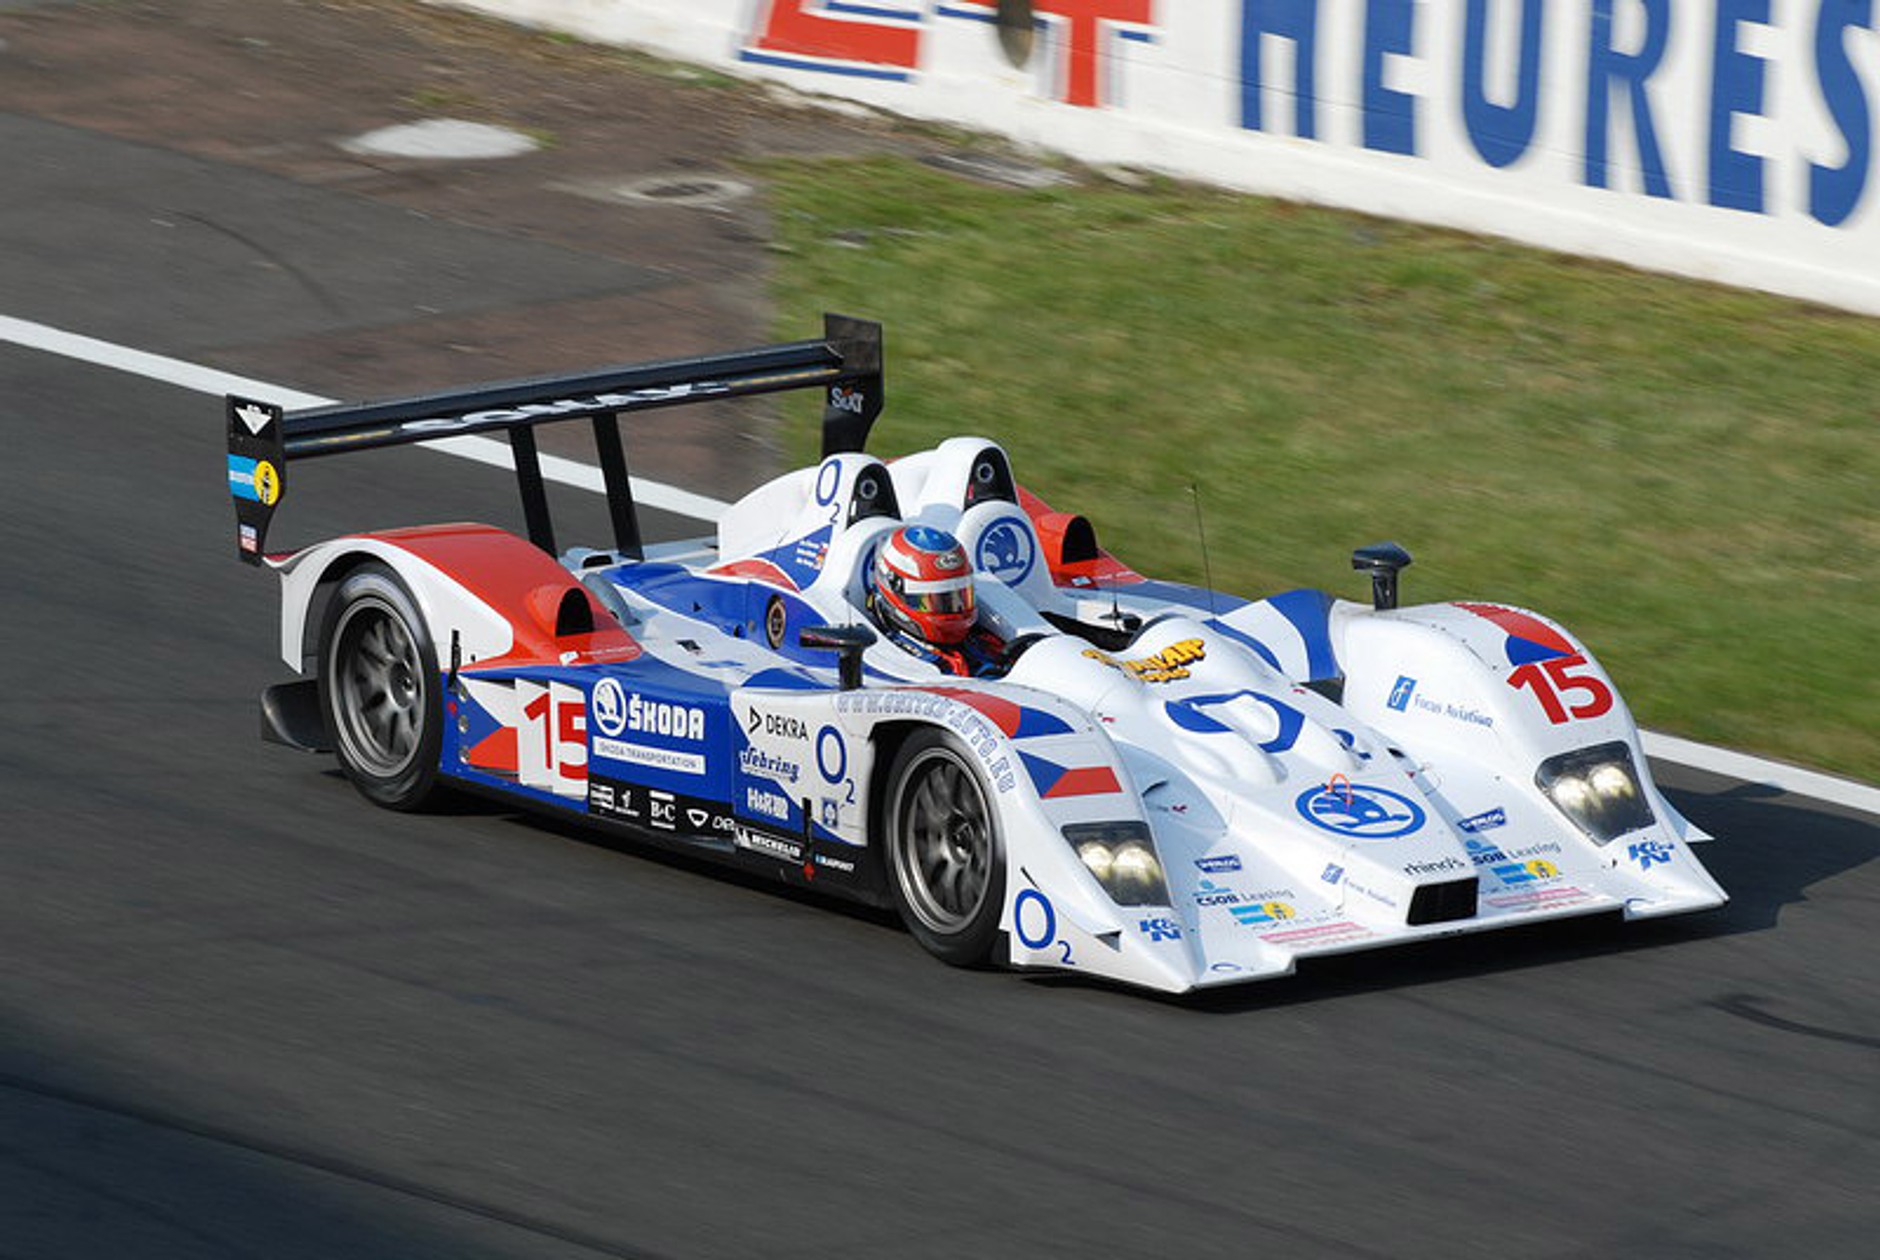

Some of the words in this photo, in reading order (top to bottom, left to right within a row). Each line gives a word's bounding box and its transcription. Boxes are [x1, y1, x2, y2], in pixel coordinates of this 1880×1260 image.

[1240, 0, 1880, 227] HEURES
[629, 693, 705, 741] ŠKODA
[766, 713, 810, 741] DEKRA
[1506, 654, 1614, 725] 15
[524, 692, 589, 781] 15
[816, 724, 855, 805] O2
[1014, 888, 1076, 965] O2
